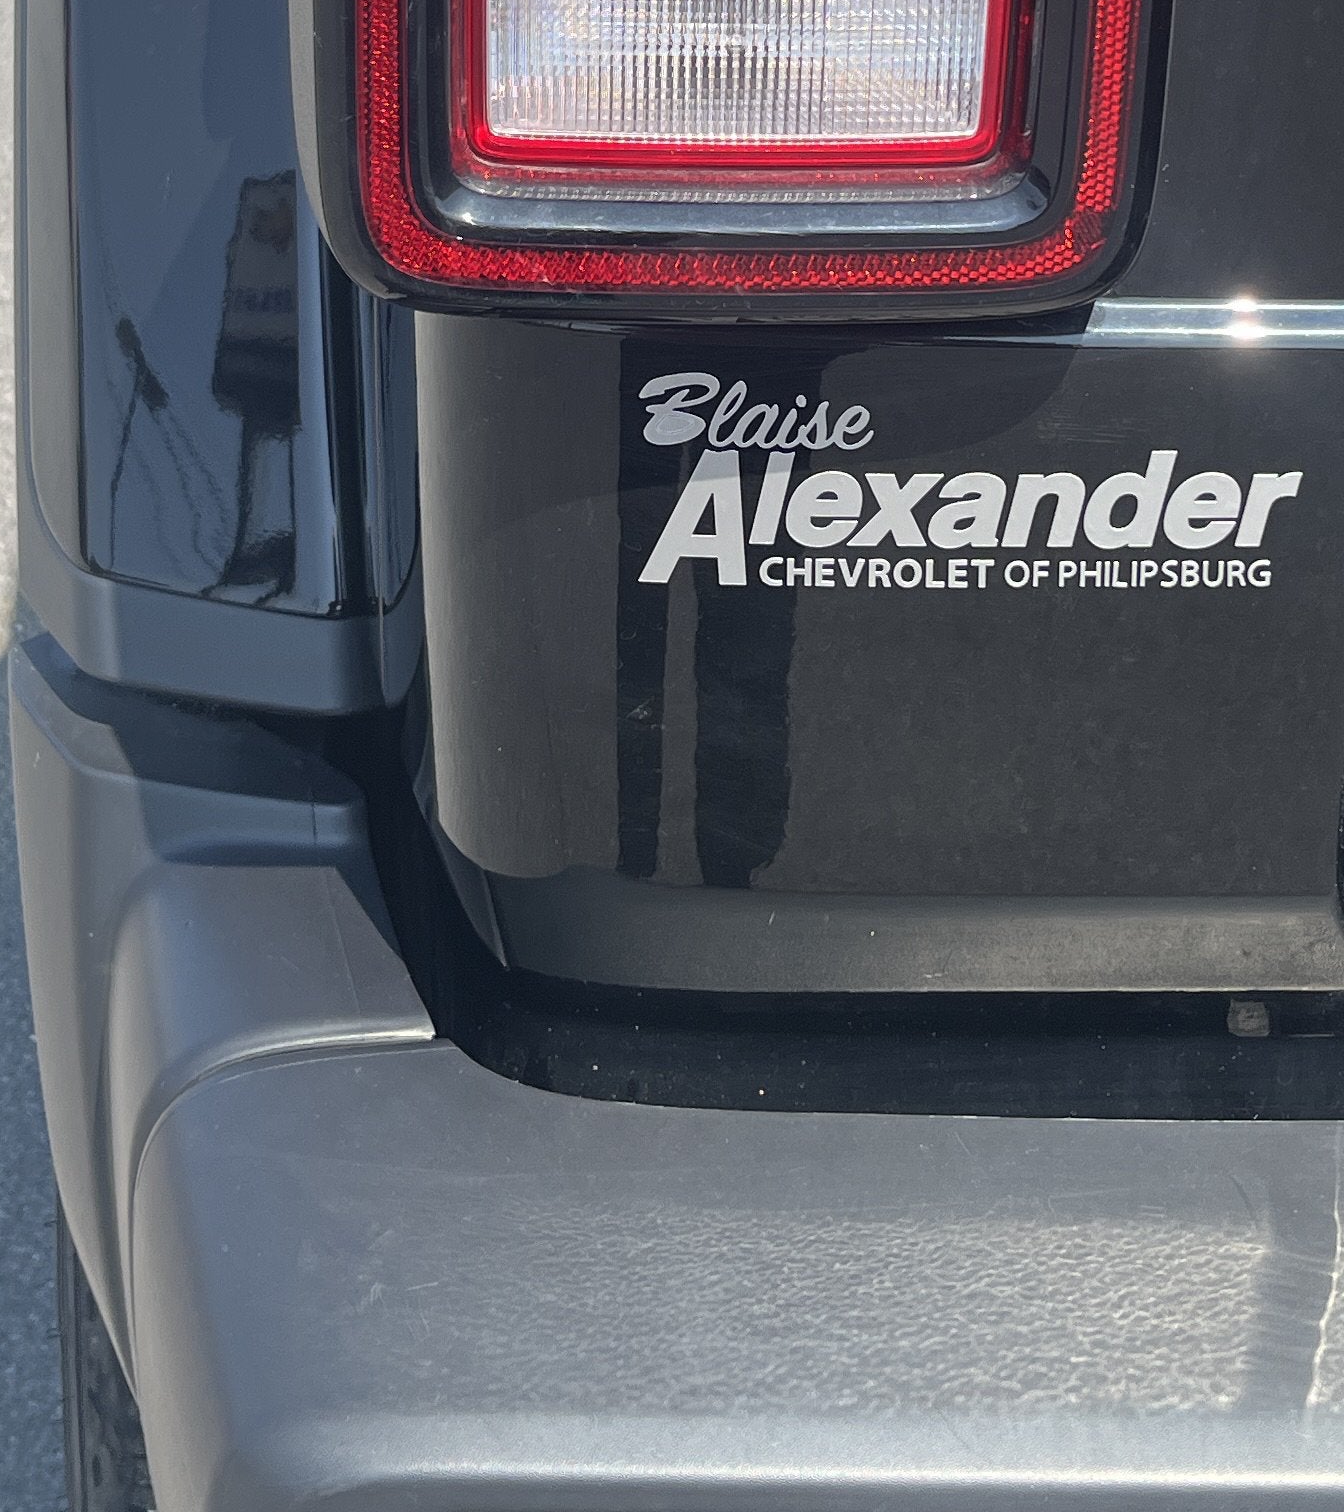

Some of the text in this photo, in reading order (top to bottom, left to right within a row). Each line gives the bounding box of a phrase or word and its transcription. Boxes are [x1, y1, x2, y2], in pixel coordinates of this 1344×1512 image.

[638, 372, 875, 450] Blaise
[637, 448, 1304, 587] Alexander
[758, 556, 1273, 589] CHEVROLET OF PHILIPSBURG
